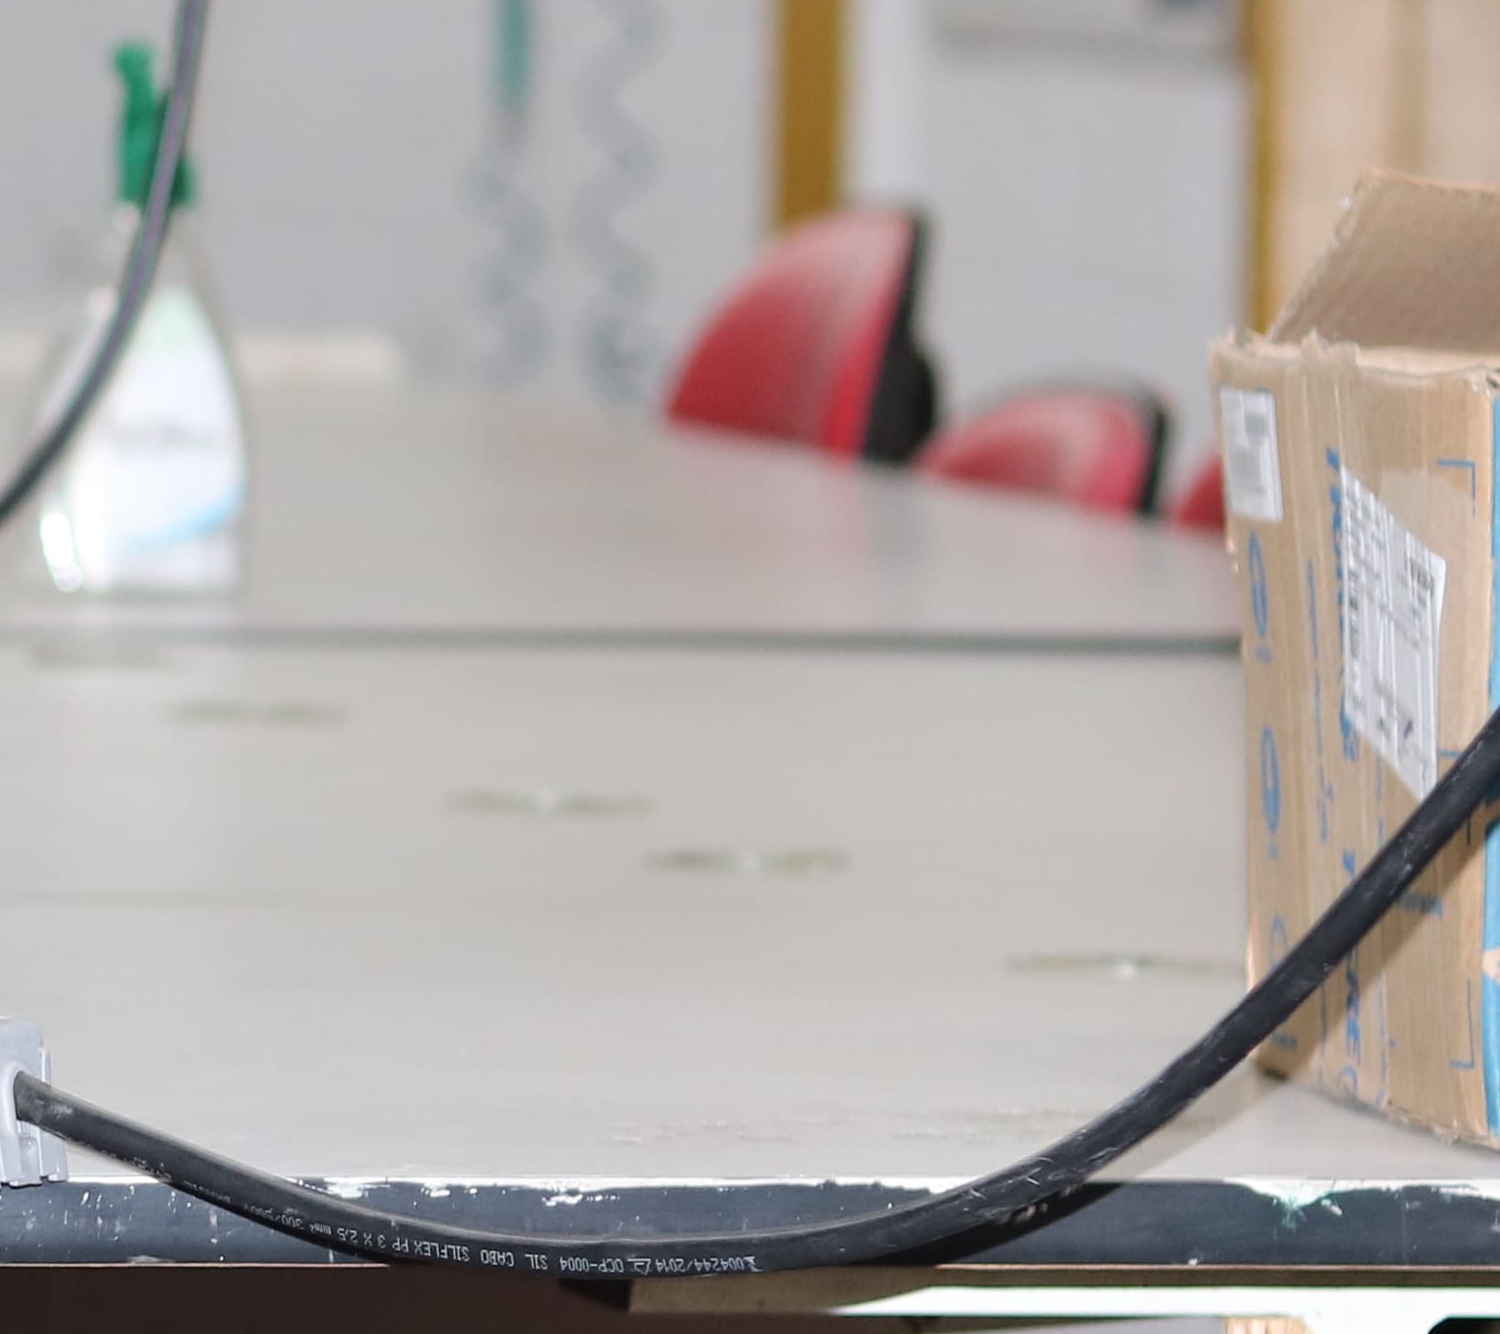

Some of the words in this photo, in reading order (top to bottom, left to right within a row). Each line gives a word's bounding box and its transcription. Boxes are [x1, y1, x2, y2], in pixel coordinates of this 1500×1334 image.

[377, 1233, 387, 1248] 3
[391, 1235, 410, 1251] PP
[412, 1239, 470, 1264] SILFLEX
[479, 1248, 515, 1268] CABO
[525, 1253, 549, 1271] SIL
